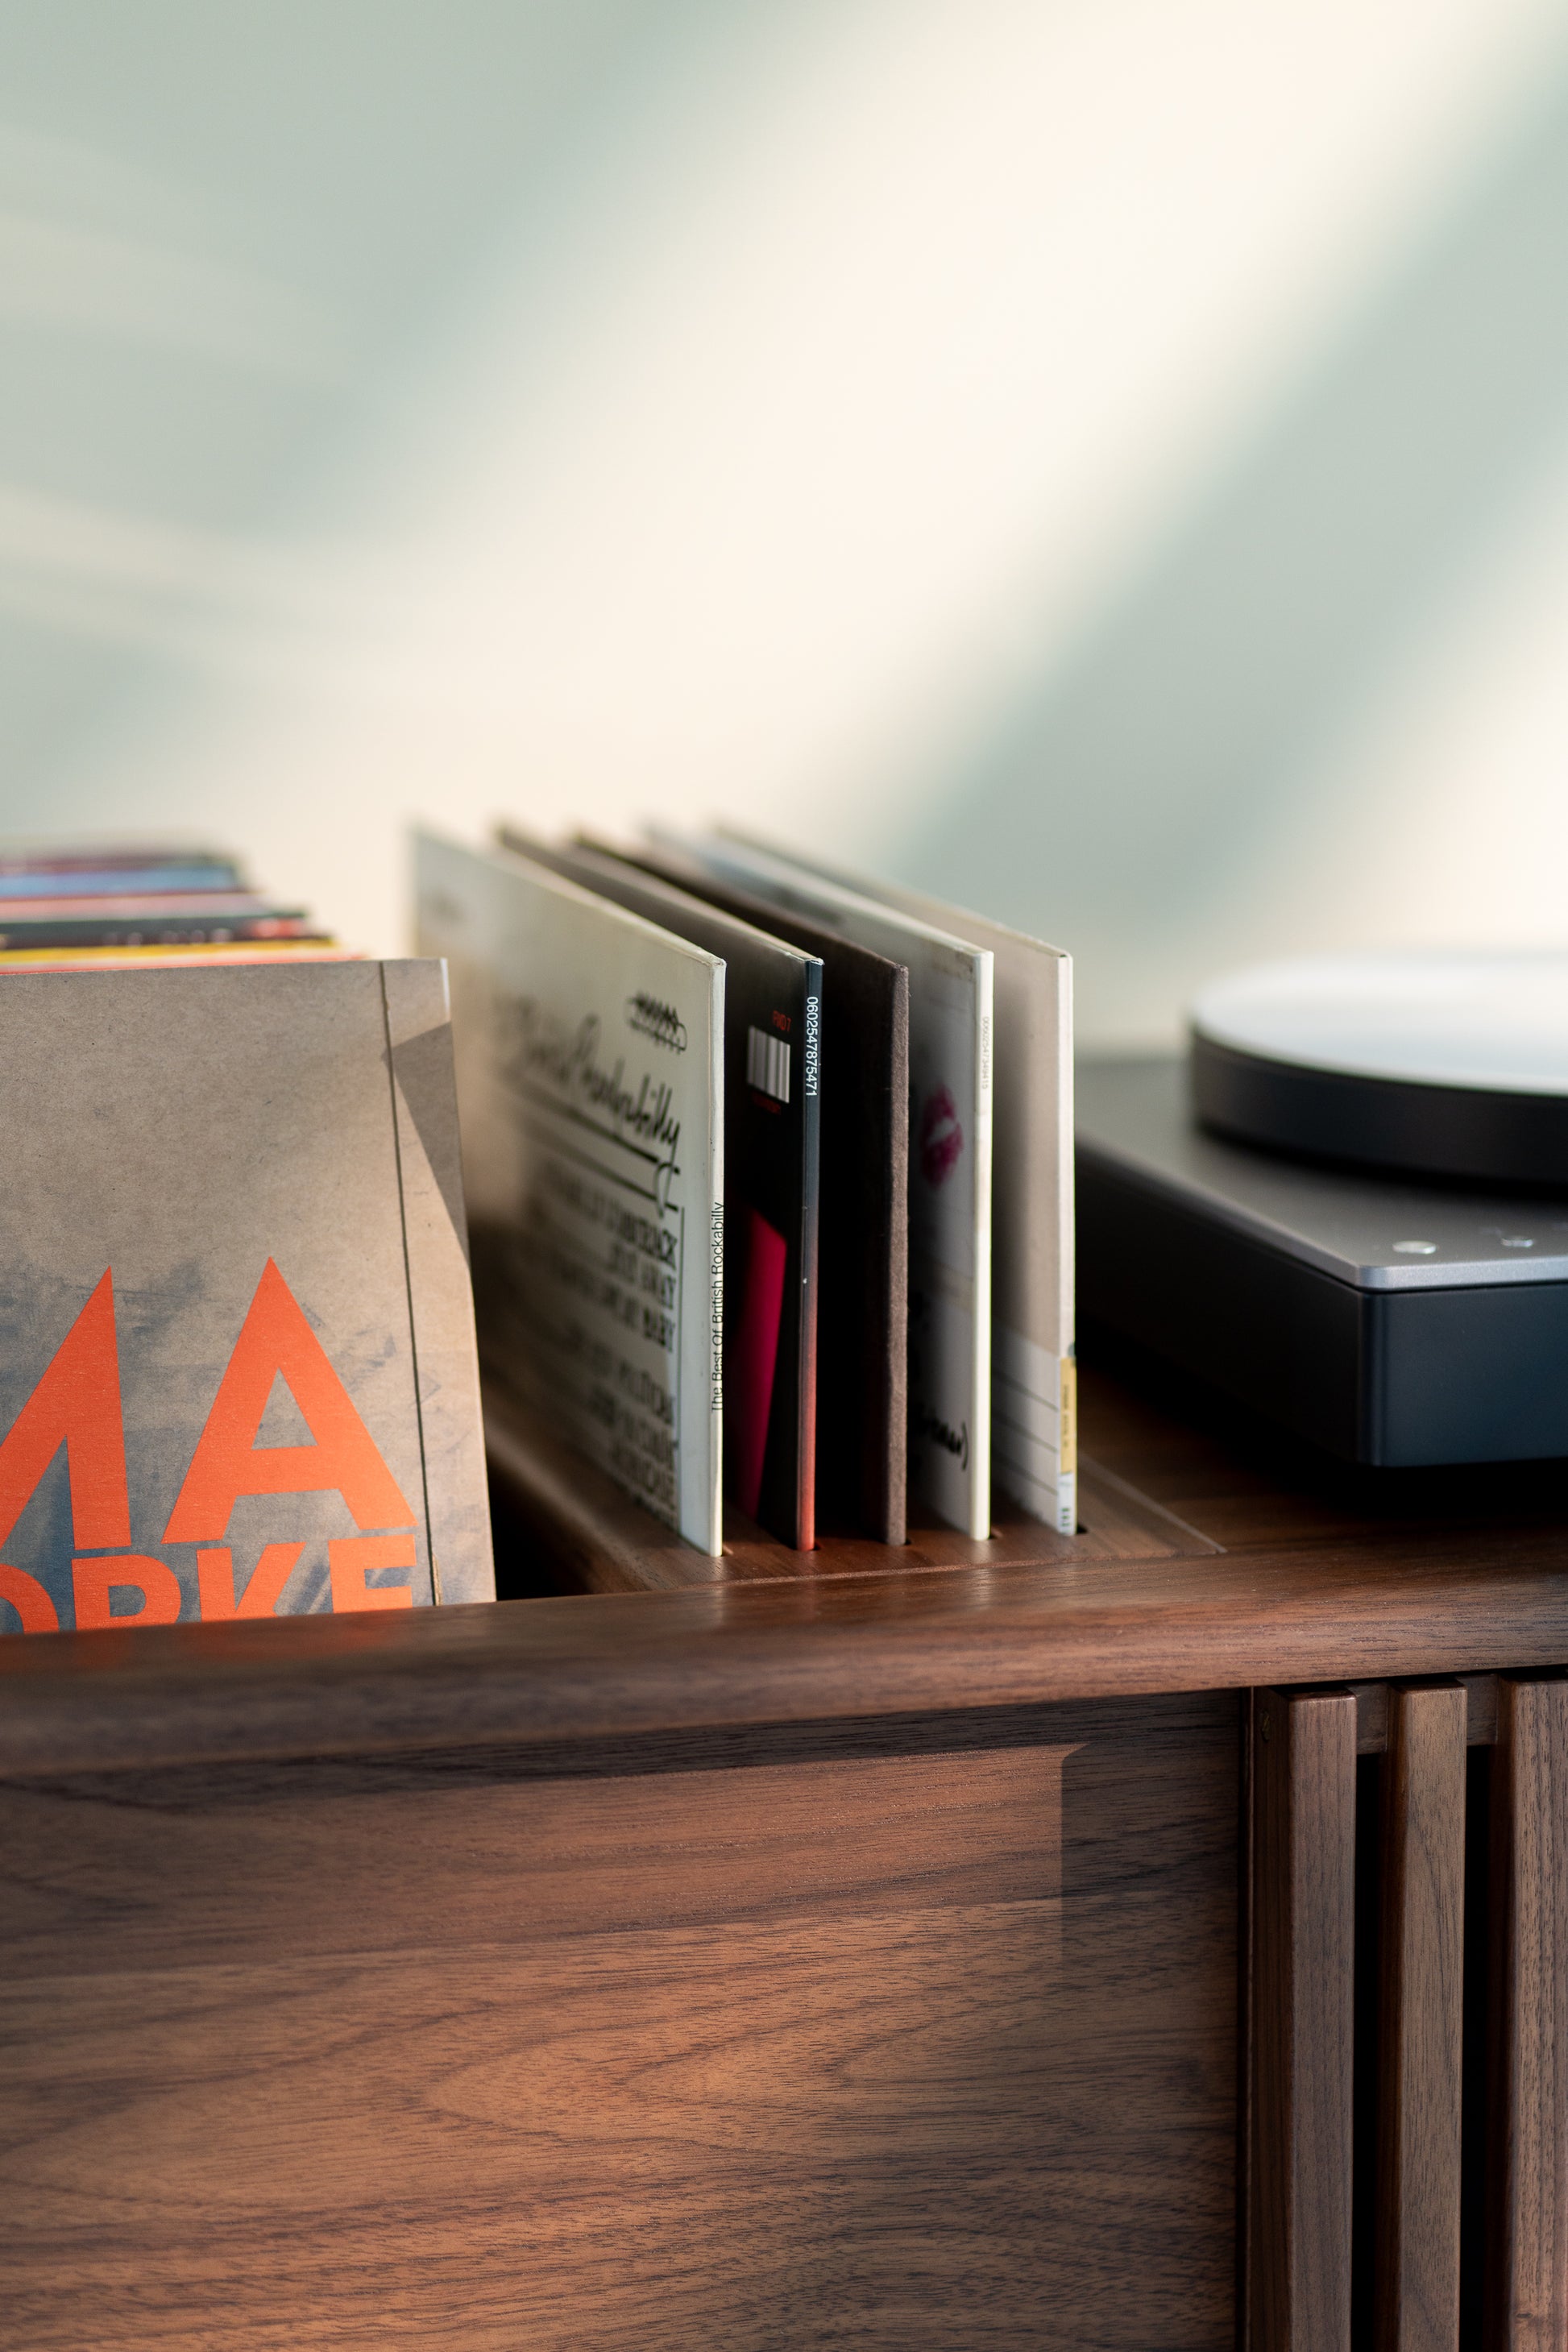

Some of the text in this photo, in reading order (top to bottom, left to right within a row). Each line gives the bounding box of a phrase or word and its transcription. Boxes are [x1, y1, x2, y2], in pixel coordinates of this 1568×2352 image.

[805, 996, 819, 1096] 0602547875471
[711, 1202, 725, 1413] The Best Of British Rockabilly
